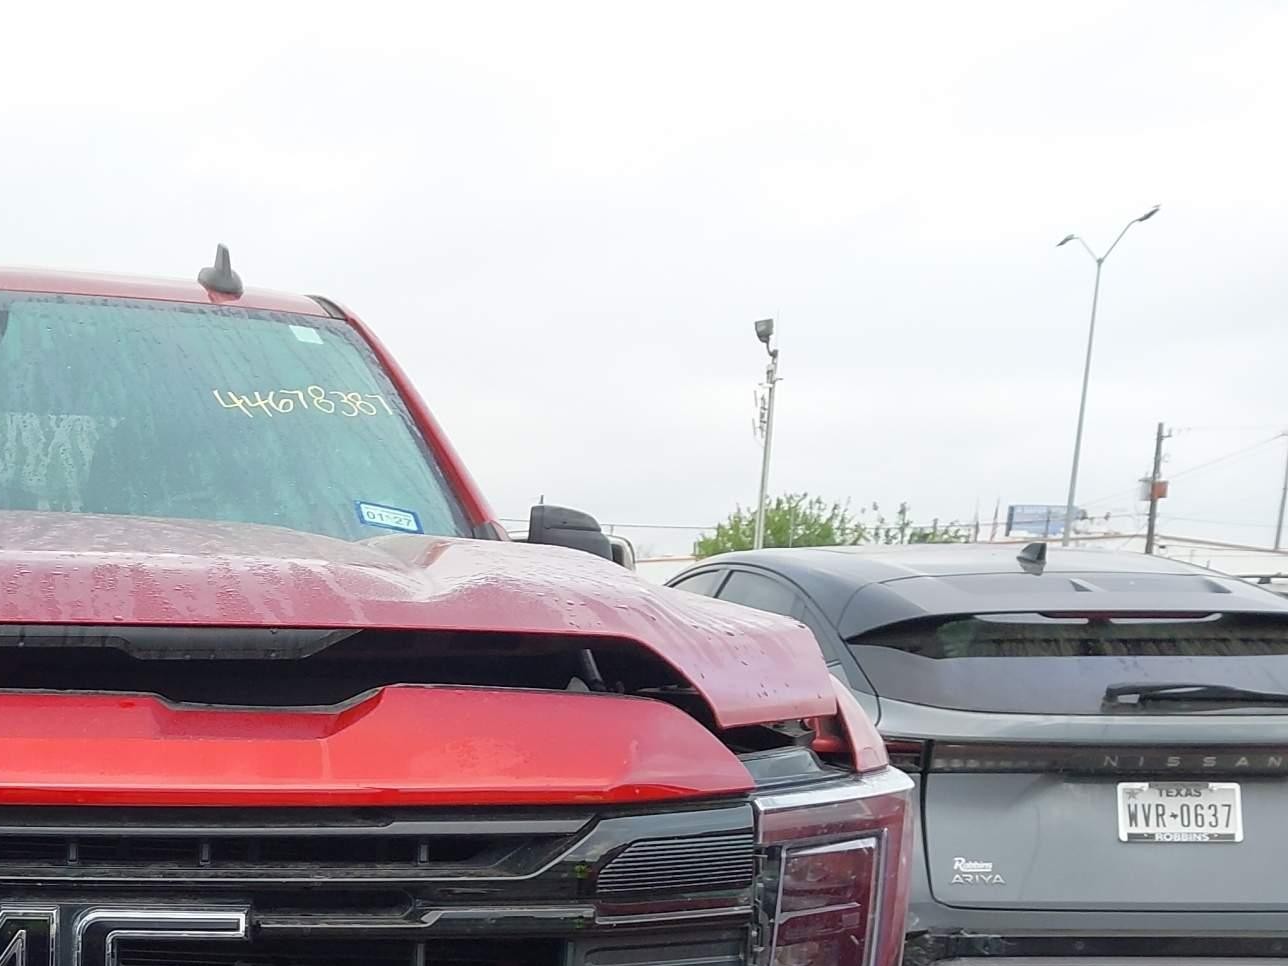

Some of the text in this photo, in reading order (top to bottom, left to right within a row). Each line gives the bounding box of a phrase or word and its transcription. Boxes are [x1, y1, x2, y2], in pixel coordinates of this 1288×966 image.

[212, 385, 394, 419] 44678387
[1103, 756, 1283, 767] NISSAN
[1157, 787, 1202, 798] TEXAS
[1154, 832, 1210, 842] ROBBINS
[951, 873, 1006, 885] ARIYA
